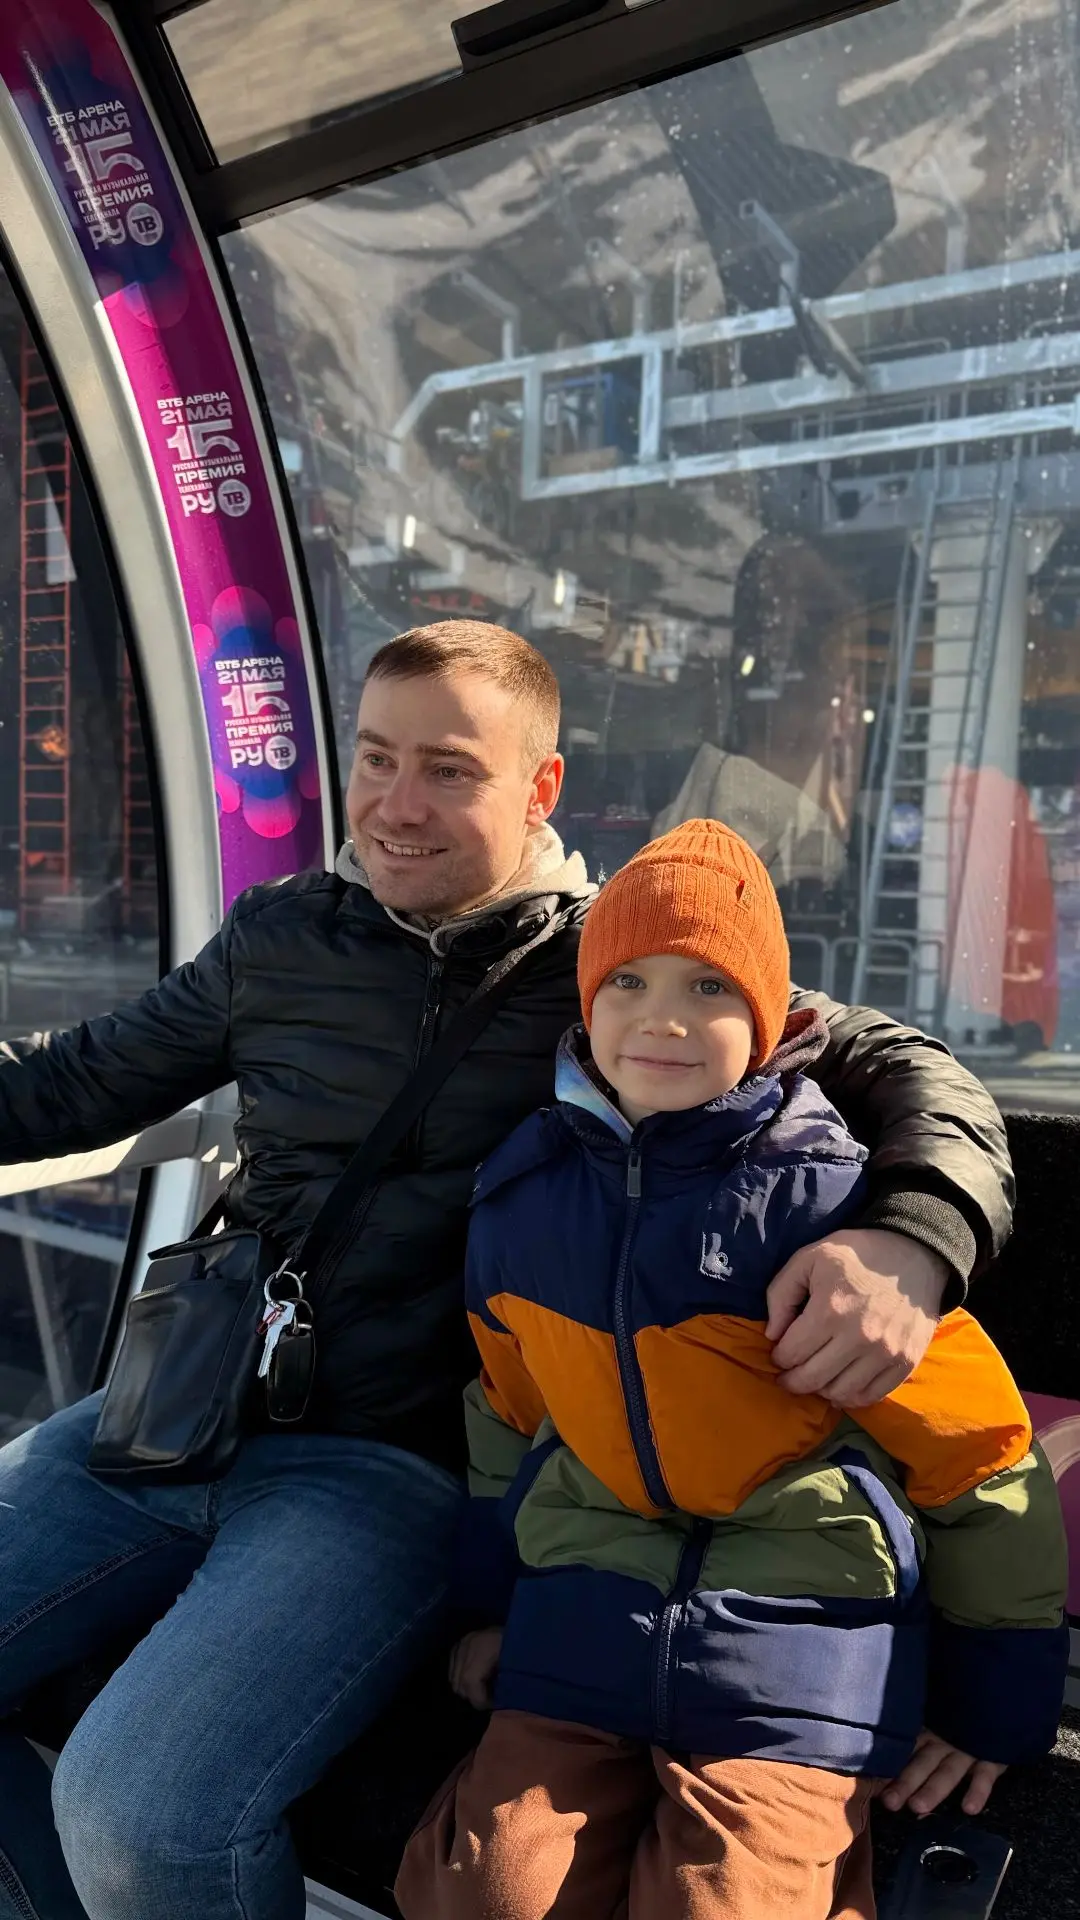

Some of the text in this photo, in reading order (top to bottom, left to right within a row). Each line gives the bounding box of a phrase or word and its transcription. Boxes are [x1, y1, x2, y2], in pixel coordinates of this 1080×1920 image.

[47, 100, 125, 127] ВТБ АРЕНА
[79, 112, 132, 139] МАЯ
[64, 131, 145, 184] 15
[73, 184, 102, 199] РУСАЯ
[78, 183, 154, 214] ПРЕМИЯ
[83, 208, 120, 224] ТЕЛЕАНАЛА
[132, 215, 157, 234] ТВ
[156, 391, 230, 409] ВТБ АРЕНА
[160, 401, 233, 425] 21 МАЯ
[165, 418, 241, 461] 15
[174, 463, 246, 485] ПРЕМИЯ
[223, 491, 245, 506] ТВ
[215, 656, 284, 671] ВТБ АРЕНА
[217, 666, 286, 685] 21 МАЯ
[221, 681, 290, 718] 15
[225, 721, 294, 740] ПРЕМИЯ
[270, 746, 290, 759] ТВ
